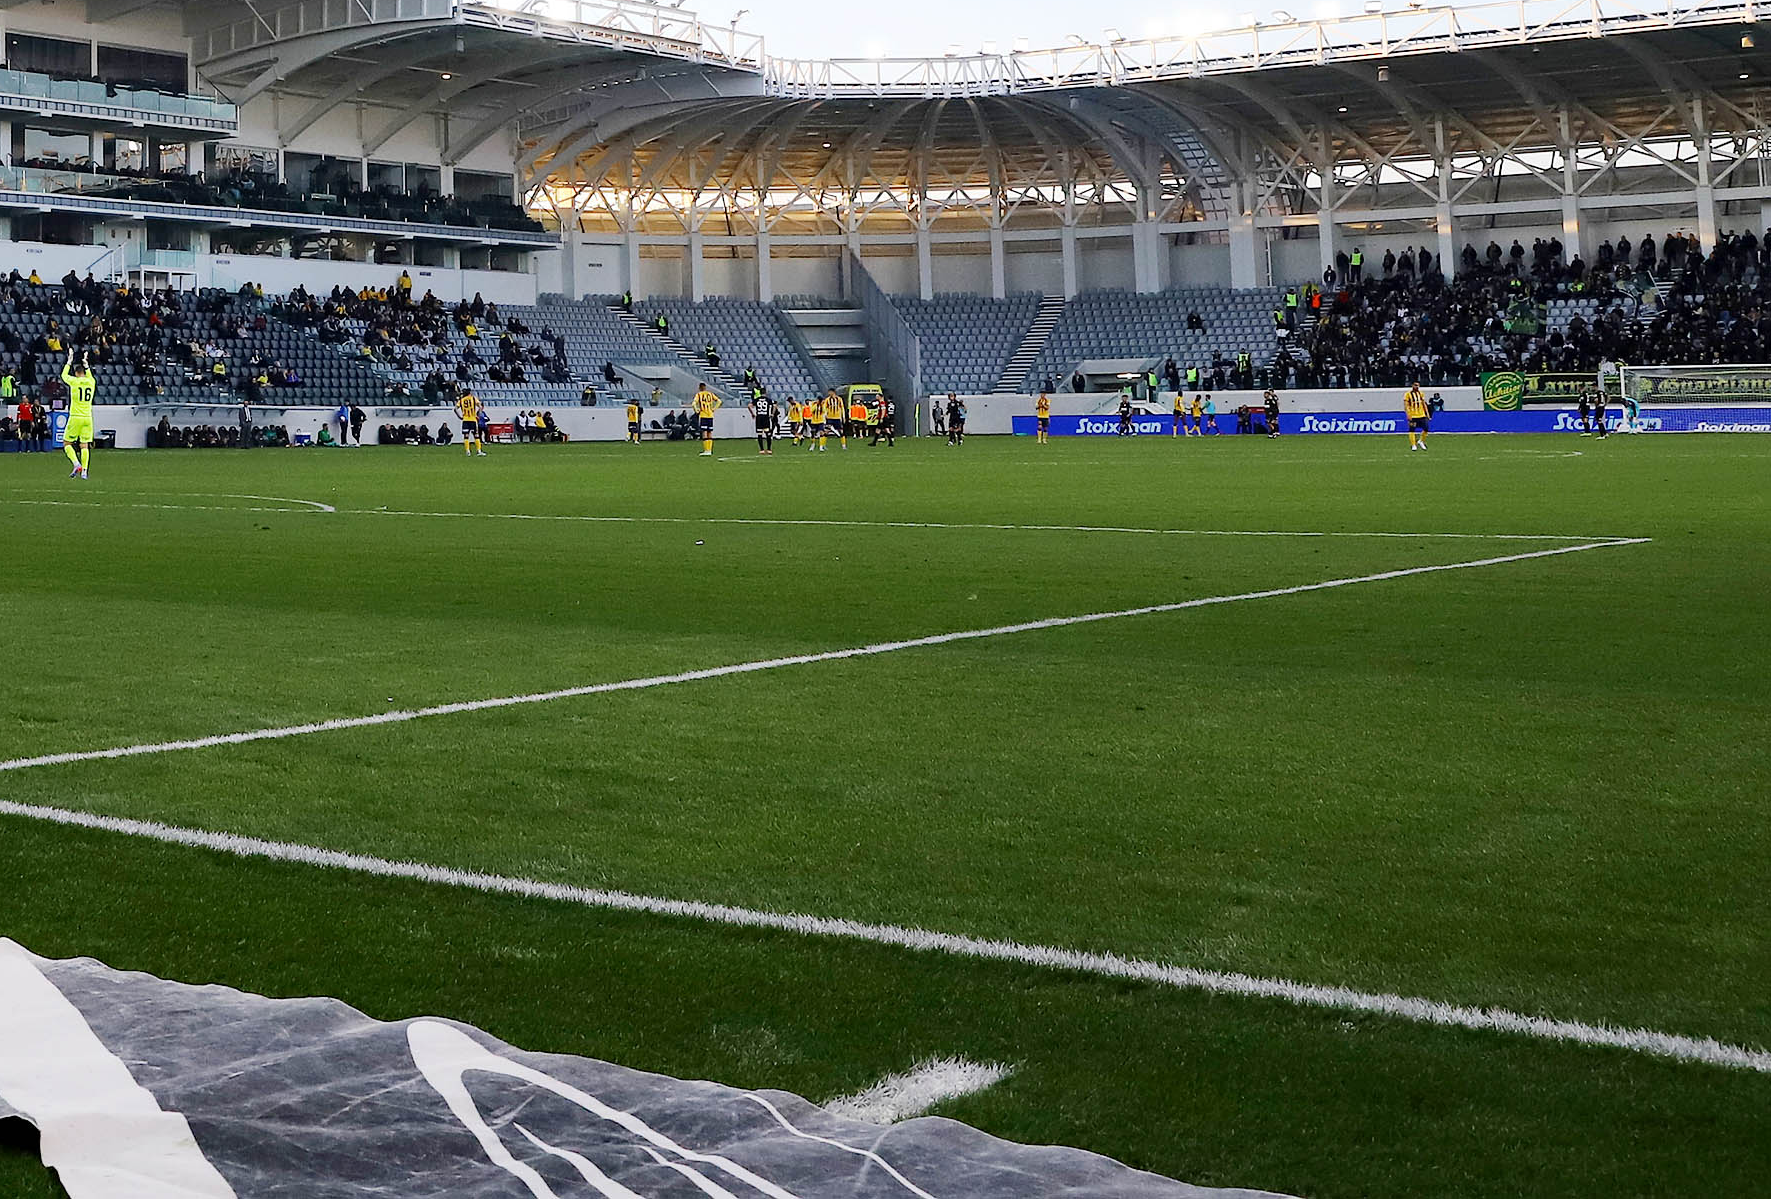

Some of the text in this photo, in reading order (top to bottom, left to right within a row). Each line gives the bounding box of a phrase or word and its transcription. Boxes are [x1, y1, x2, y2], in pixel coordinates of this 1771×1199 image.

[78, 387, 91, 401] 16
[756, 401, 768, 411] 99
[1300, 416, 1396, 432] Stoiximan
[1694, 422, 1771, 433] Stoiximan
